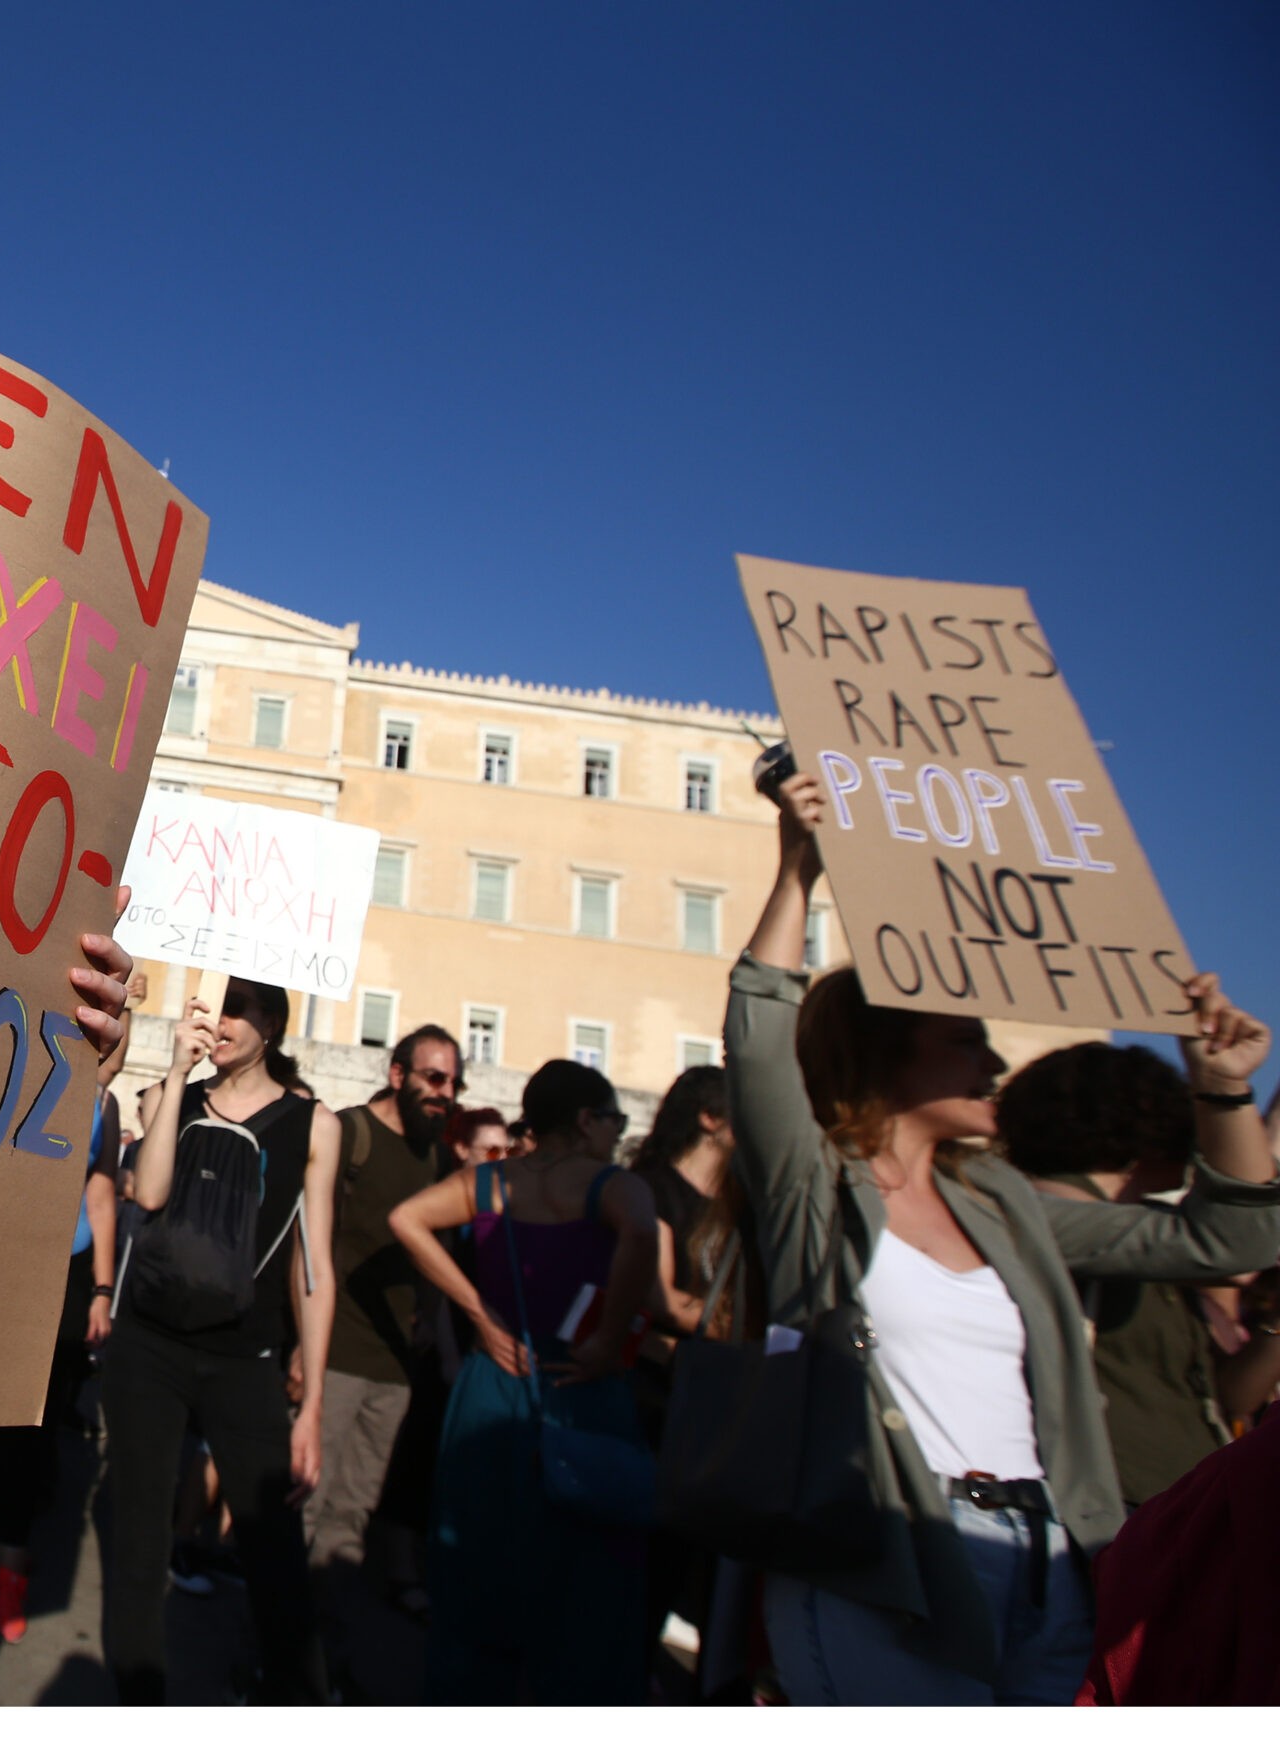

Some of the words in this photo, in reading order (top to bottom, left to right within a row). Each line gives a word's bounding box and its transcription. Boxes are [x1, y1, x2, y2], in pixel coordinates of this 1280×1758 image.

[765, 589, 1059, 678] RAPISTS
[833, 679, 1027, 768] RAPE
[146, 814, 294, 885] ΚΑΜΙΑ
[818, 750, 1116, 873] PEOPLE
[933, 856, 1078, 944] NOT
[160, 923, 349, 989] ΣΕΞΙΣΜΟ
